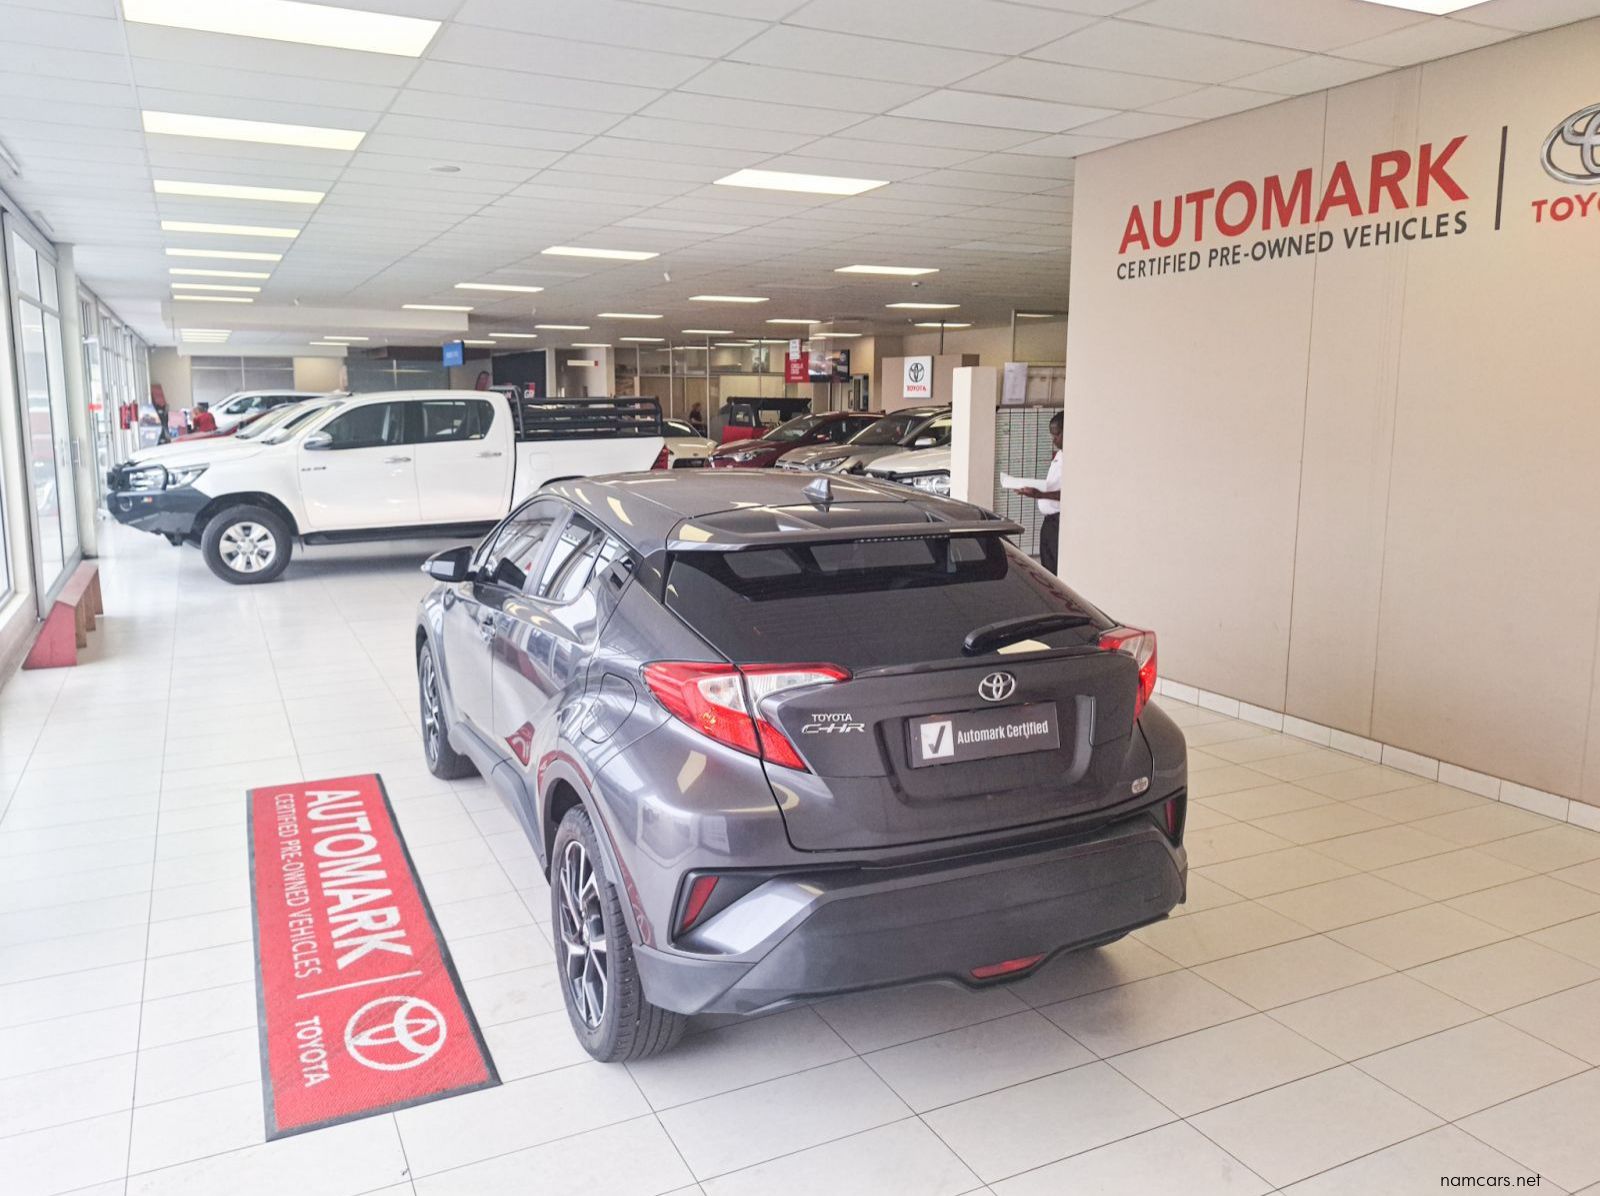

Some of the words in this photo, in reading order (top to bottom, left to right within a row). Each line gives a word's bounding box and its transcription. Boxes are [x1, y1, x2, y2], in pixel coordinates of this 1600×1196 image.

[1118, 135, 1469, 254] AUTOMARK
[1531, 192, 1600, 223] TOY
[1116, 251, 1201, 280] CERTIFIED
[1208, 230, 1334, 268] PRE-OWNED
[1343, 210, 1468, 250] VEHICLES
[811, 713, 853, 722] TOYOTA
[957, 725, 1006, 745] Automark
[1006, 720, 1049, 739] Certified
[274, 793, 299, 838] CERTIFIED
[279, 839, 311, 908] PRE-OWNED
[304, 789, 413, 970] AUTOMARK
[287, 907, 322, 979] VEHICLES
[294, 1015, 330, 1088] TOYOTA
